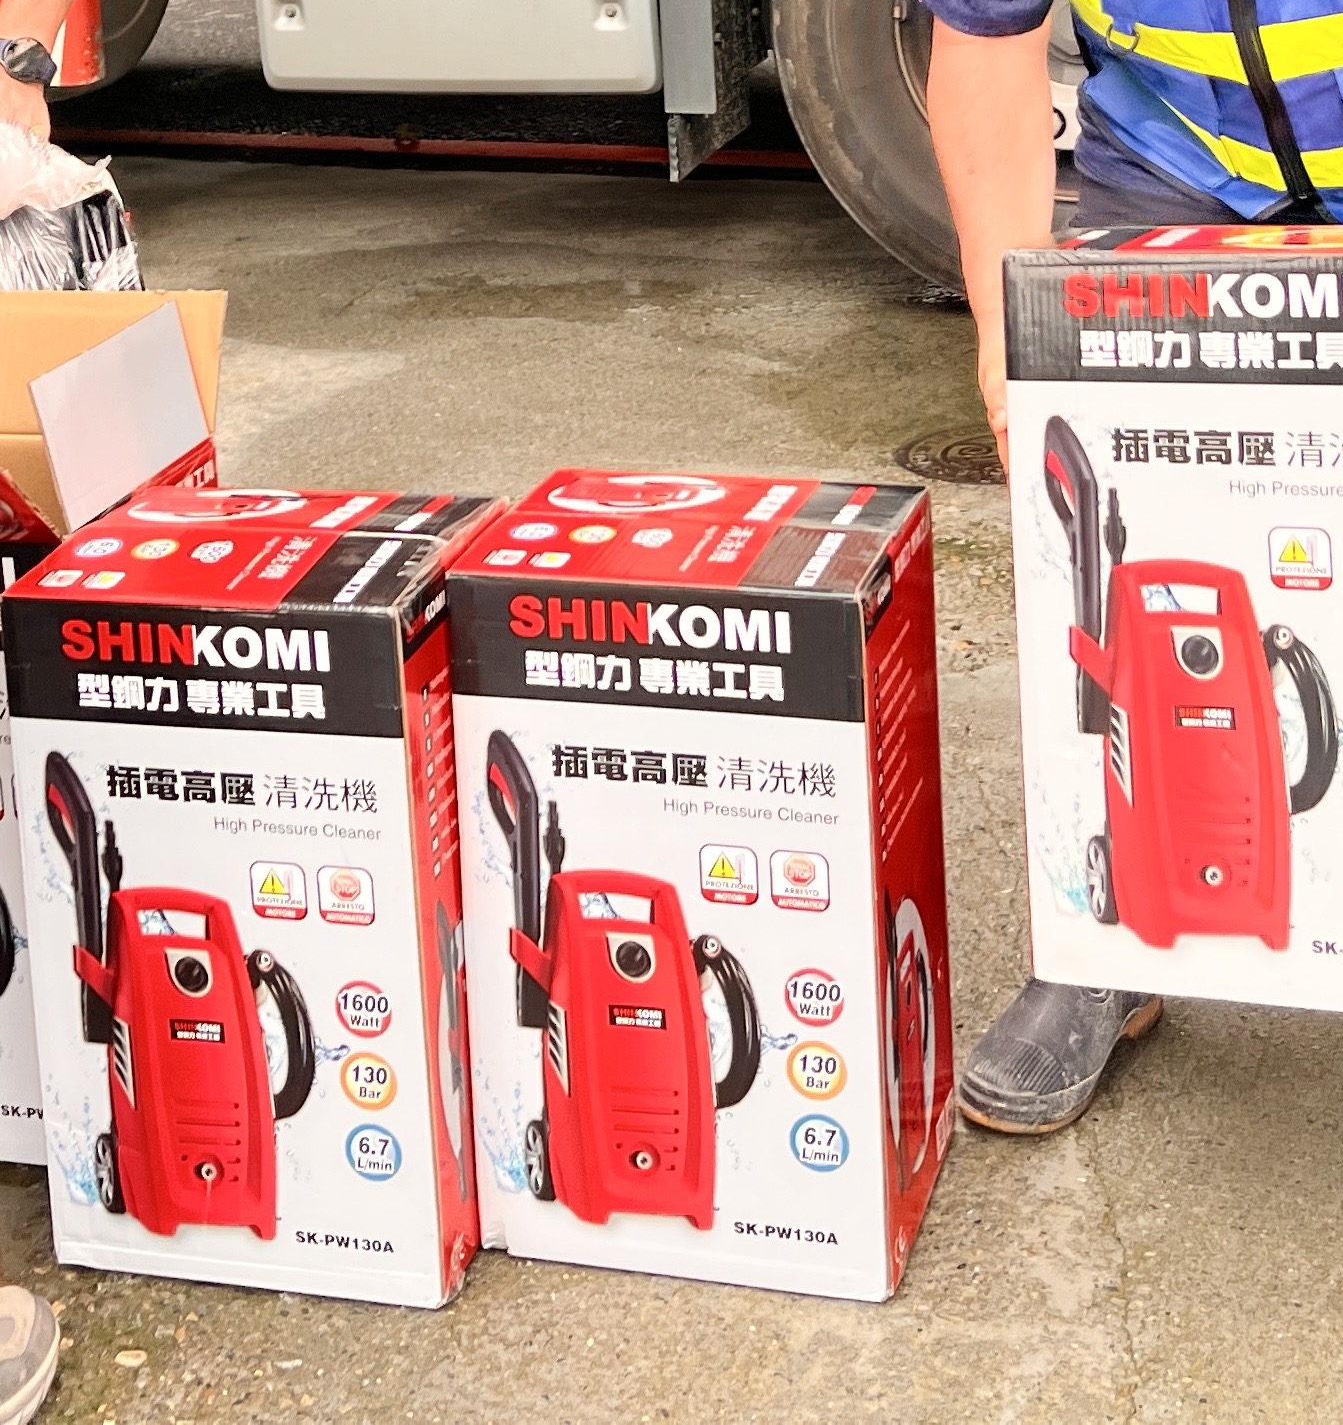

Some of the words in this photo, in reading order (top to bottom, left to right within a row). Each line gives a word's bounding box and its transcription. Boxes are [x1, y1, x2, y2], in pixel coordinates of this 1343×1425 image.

[1079, 329, 1191, 368] 型鋼力
[1112, 427, 1276, 467] 插電高壓
[1229, 479, 1265, 498] High
[508, 594, 792, 654] SHINKOMI
[61, 619, 331, 673] SHINKOMI
[524, 649, 632, 692] 型鋼力
[638, 656, 786, 702] 專業工具
[77, 672, 179, 713] 型鋼力
[185, 678, 326, 720] 專業工具
[552, 743, 708, 788] 插電高壓
[717, 755, 837, 799] 清洗機
[106, 764, 256, 807] 插電高壓
[263, 773, 378, 815] 清洗機
[663, 797, 698, 817] High
[704, 800, 772, 820] Pressure
[777, 806, 839, 825] Cleaner
[214, 816, 247, 834] High
[252, 818, 318, 837] Pressure
[323, 823, 382, 841] Cleaner
[790, 980, 841, 1002] 1600
[340, 992, 389, 1014] 1600
[799, 1002, 831, 1017] Watt
[350, 1014, 380, 1028] Watt
[352, 1064, 388, 1085] 130
[799, 1054, 837, 1075] 130
[359, 1086, 382, 1100] Bar
[806, 1076, 830, 1090] Bar
[358, 1136, 390, 1156] 6.7
[804, 1126, 837, 1147] 6.7
[357, 1156, 393, 1172] L/min
[802, 1147, 839, 1163] L/min
[295, 1230, 395, 1254] SK-PW130A
[733, 1221, 839, 1245] SK-PW130A
